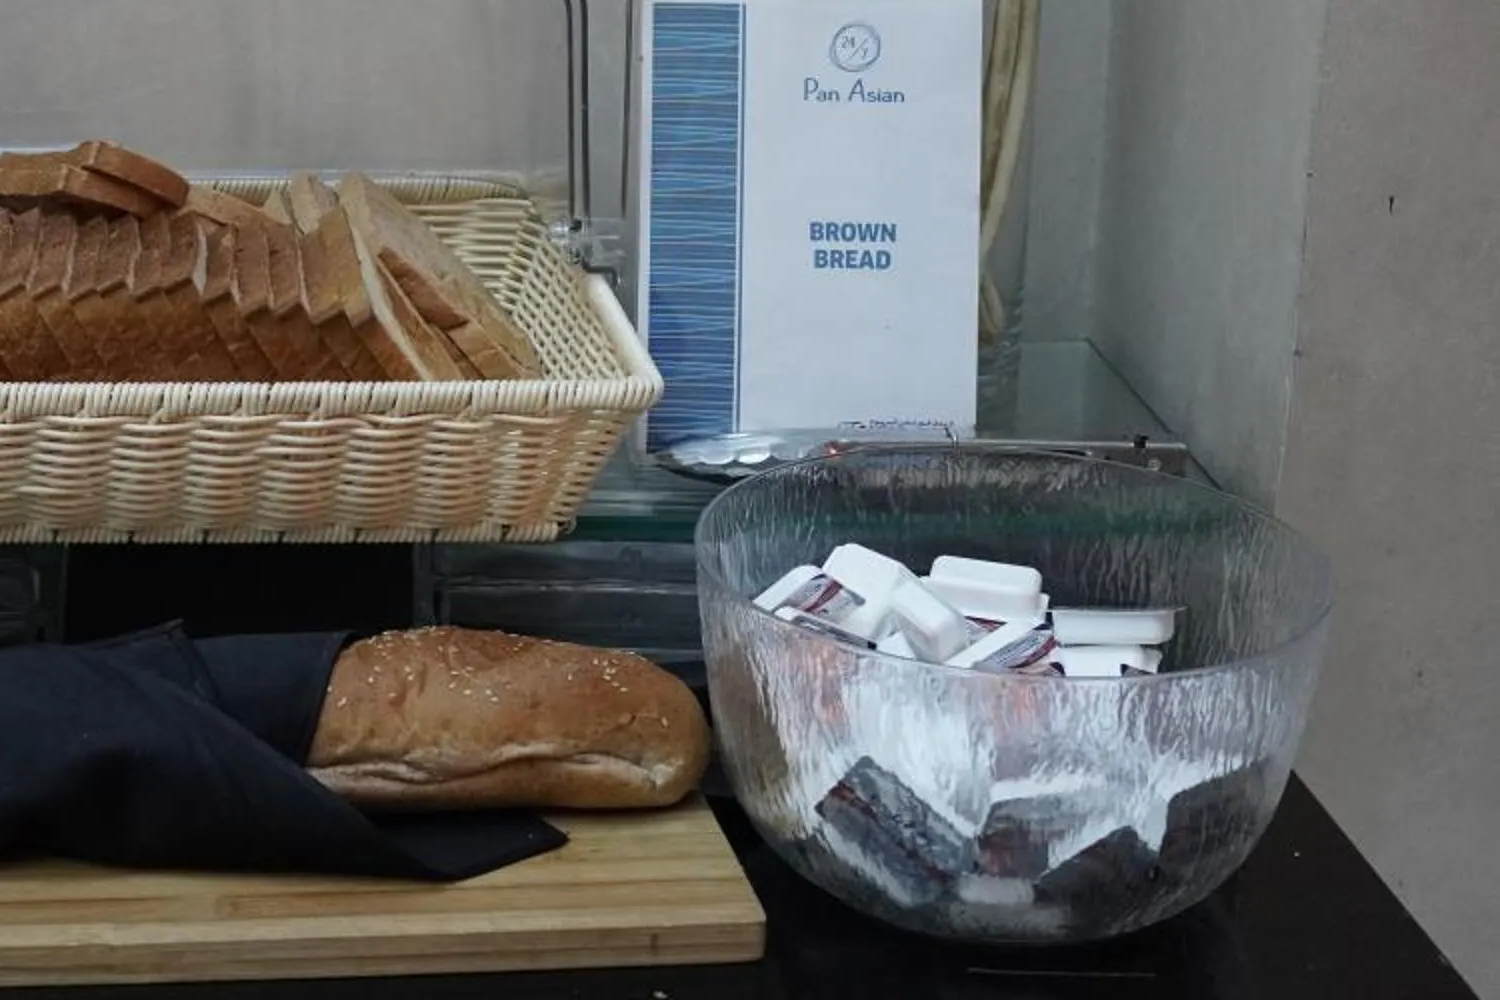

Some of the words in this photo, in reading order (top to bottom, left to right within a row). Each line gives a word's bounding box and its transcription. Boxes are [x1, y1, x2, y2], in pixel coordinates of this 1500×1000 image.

[803, 77, 840, 102] Pan
[848, 78, 905, 103] Asian
[809, 221, 897, 242] BROWN
[814, 249, 891, 270] BREAD
